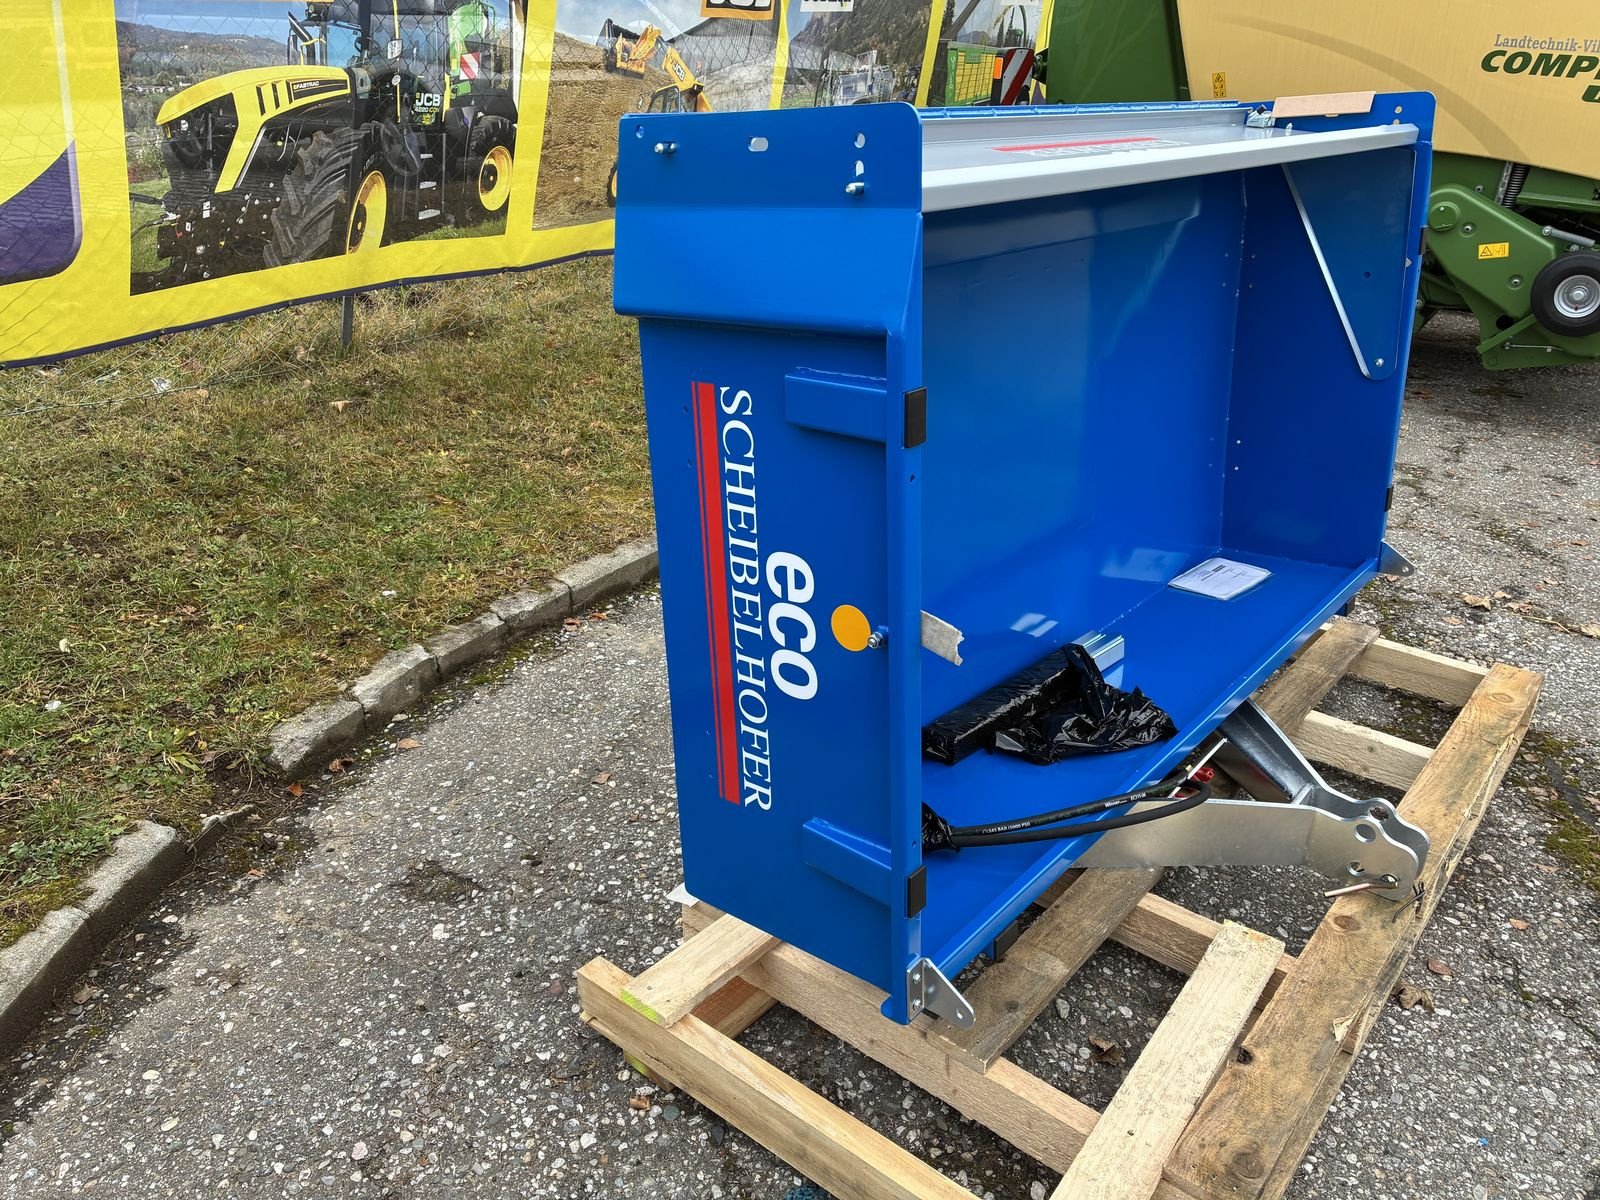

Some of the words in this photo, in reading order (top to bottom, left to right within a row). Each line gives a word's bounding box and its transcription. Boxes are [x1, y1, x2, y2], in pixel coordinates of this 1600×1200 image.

[415, 92, 441, 107] JCB
[719, 386, 772, 812] SCHEIBELHOFER
[766, 551, 818, 701] eco
